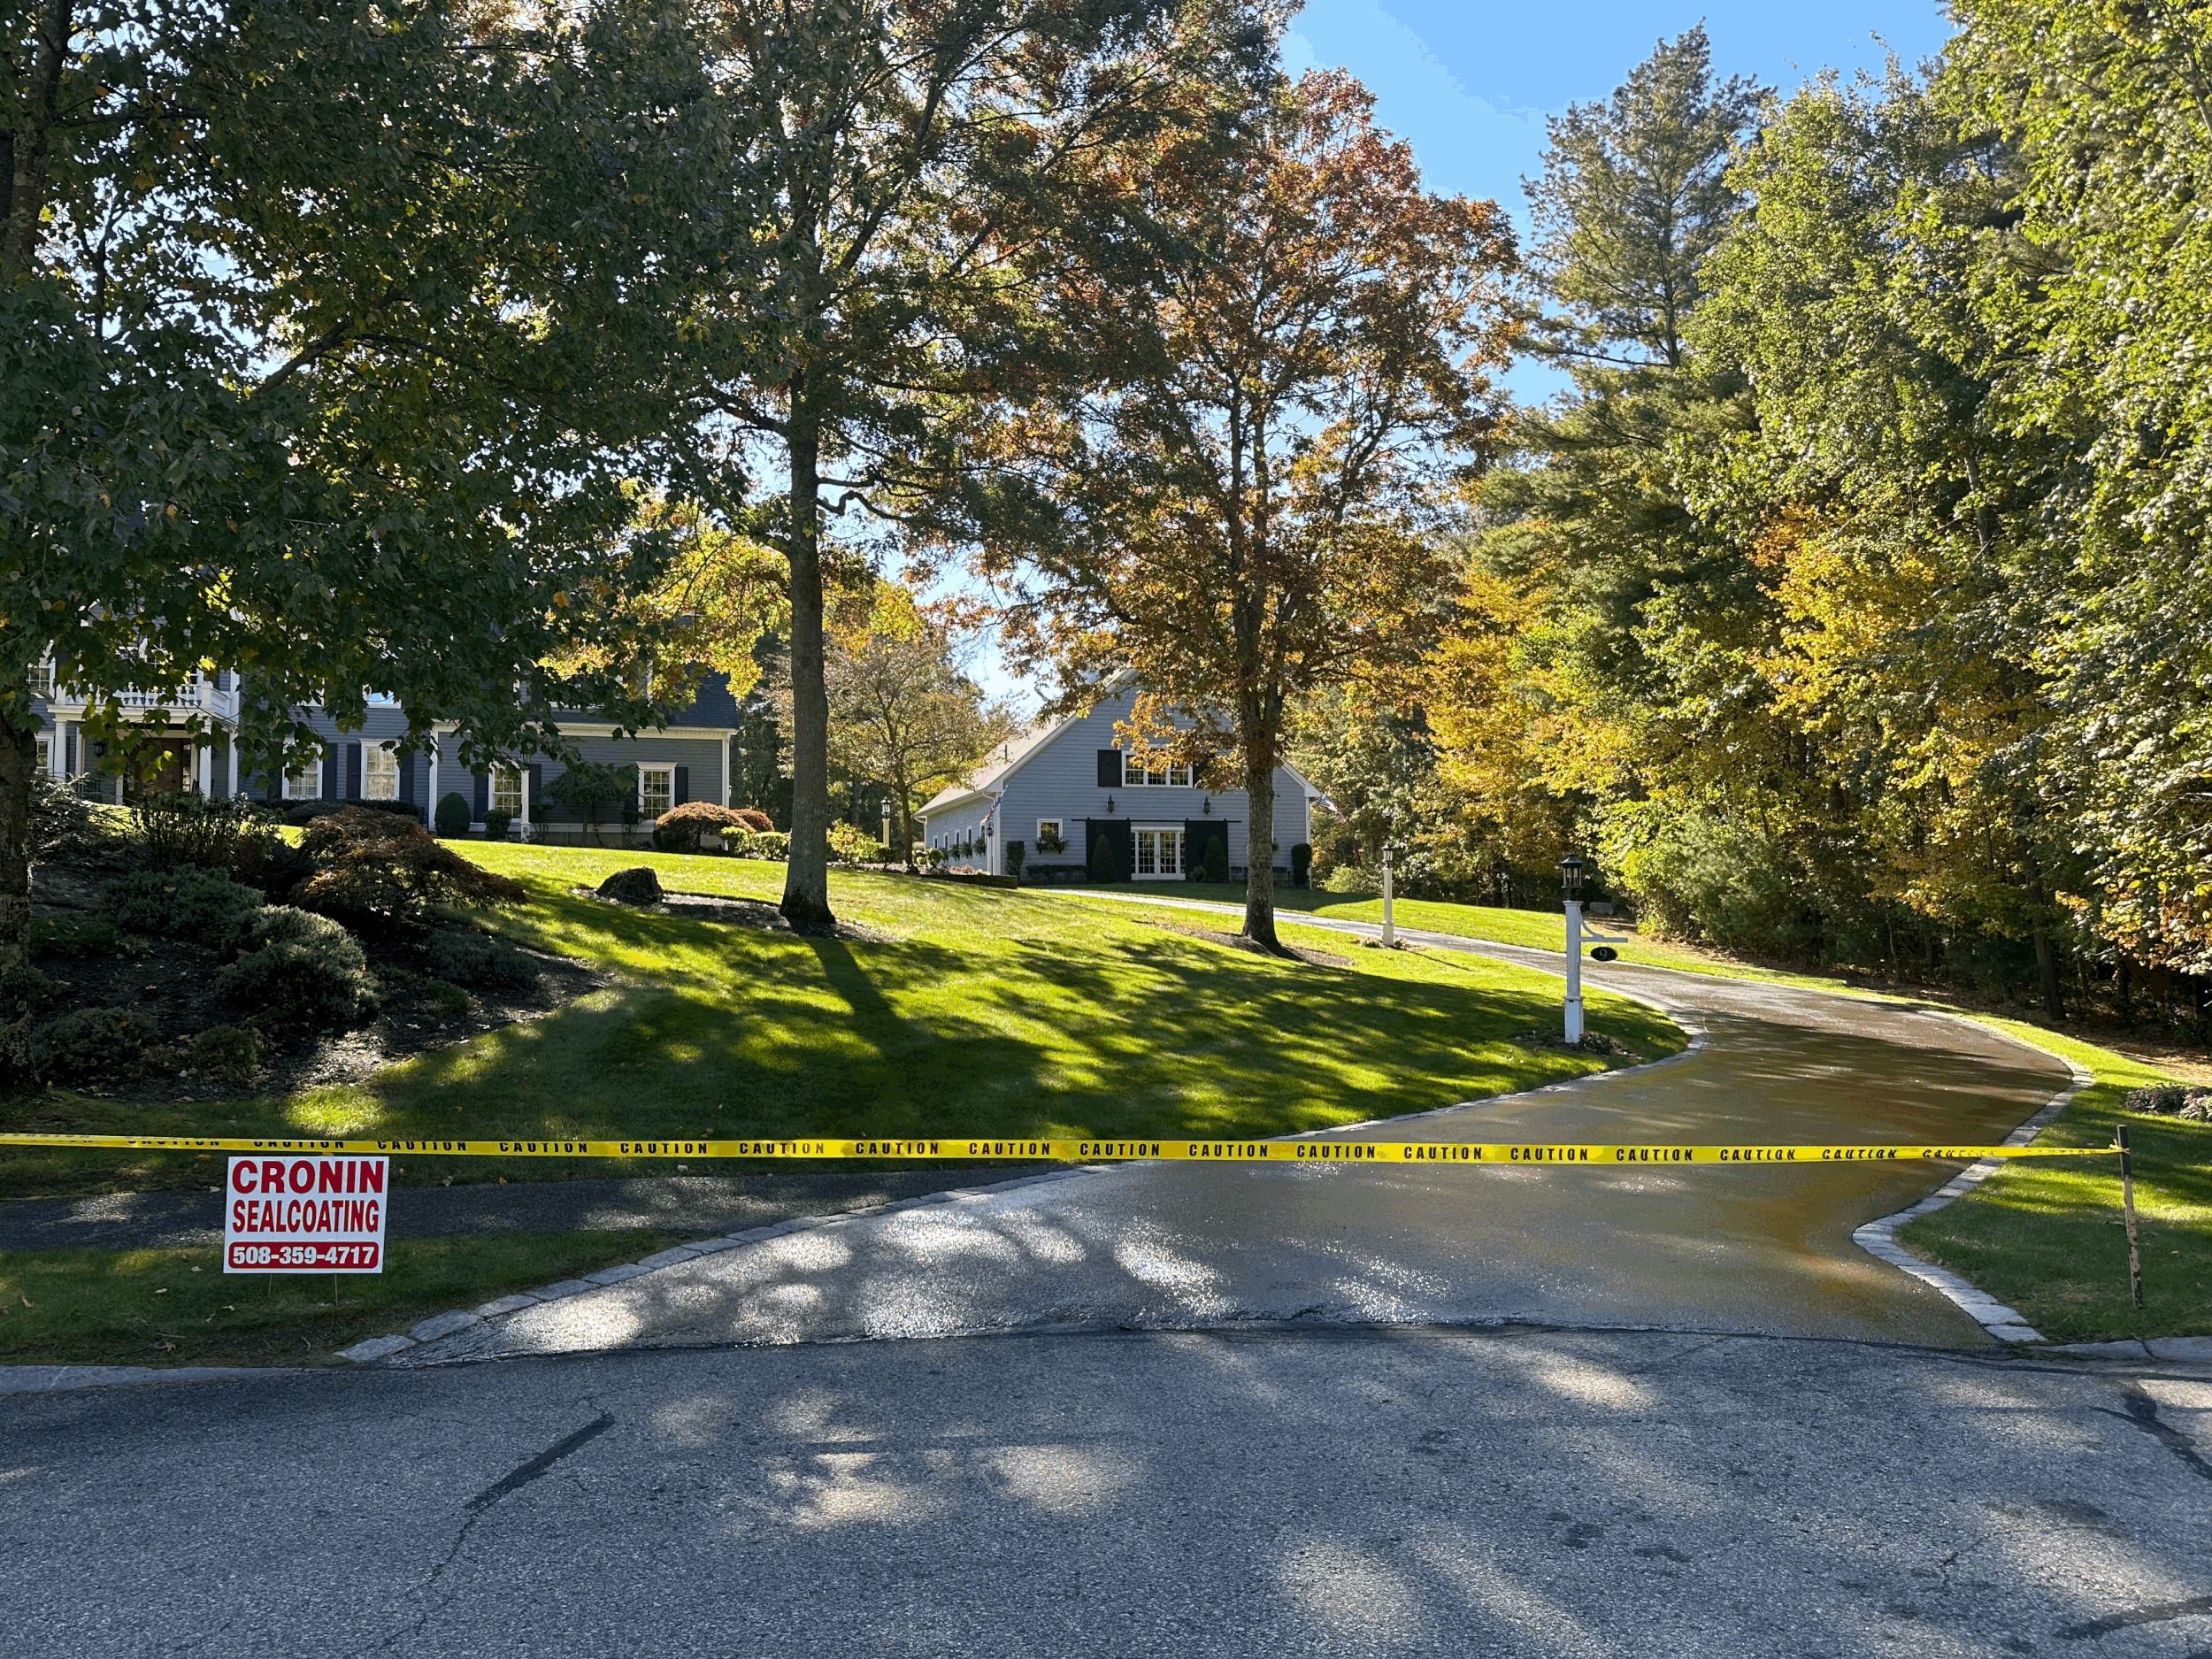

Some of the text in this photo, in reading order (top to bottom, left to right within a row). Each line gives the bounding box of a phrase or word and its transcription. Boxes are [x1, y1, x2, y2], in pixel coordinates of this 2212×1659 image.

[1600, 949, 1607, 960] 9
[377, 1141, 466, 1151] CAUTION
[499, 1142, 588, 1153] CAUTION
[620, 1142, 707, 1154] CAUTION
[740, 1142, 825, 1155] CAUTION
[856, 1142, 939, 1155] CAUTION
[969, 1142, 1050, 1156] CAUTION
[1079, 1142, 1160, 1156] CAUTION
[1189, 1143, 1268, 1157] CAUTION
[1296, 1144, 1375, 1158] CAUTION
[1404, 1146, 1482, 1160] CAUTION
[1510, 1148, 1587, 1161] CAUTION
[1617, 1148, 1693, 1161] CAUTION
[1720, 1148, 1795, 1160] CAUTION
[1822, 1148, 1896, 1160] CAUTION
[232, 1160, 384, 1194] CRONIN
[232, 1199, 379, 1233] SEALCOATING
[233, 1246, 375, 1264] 508-359-4717
